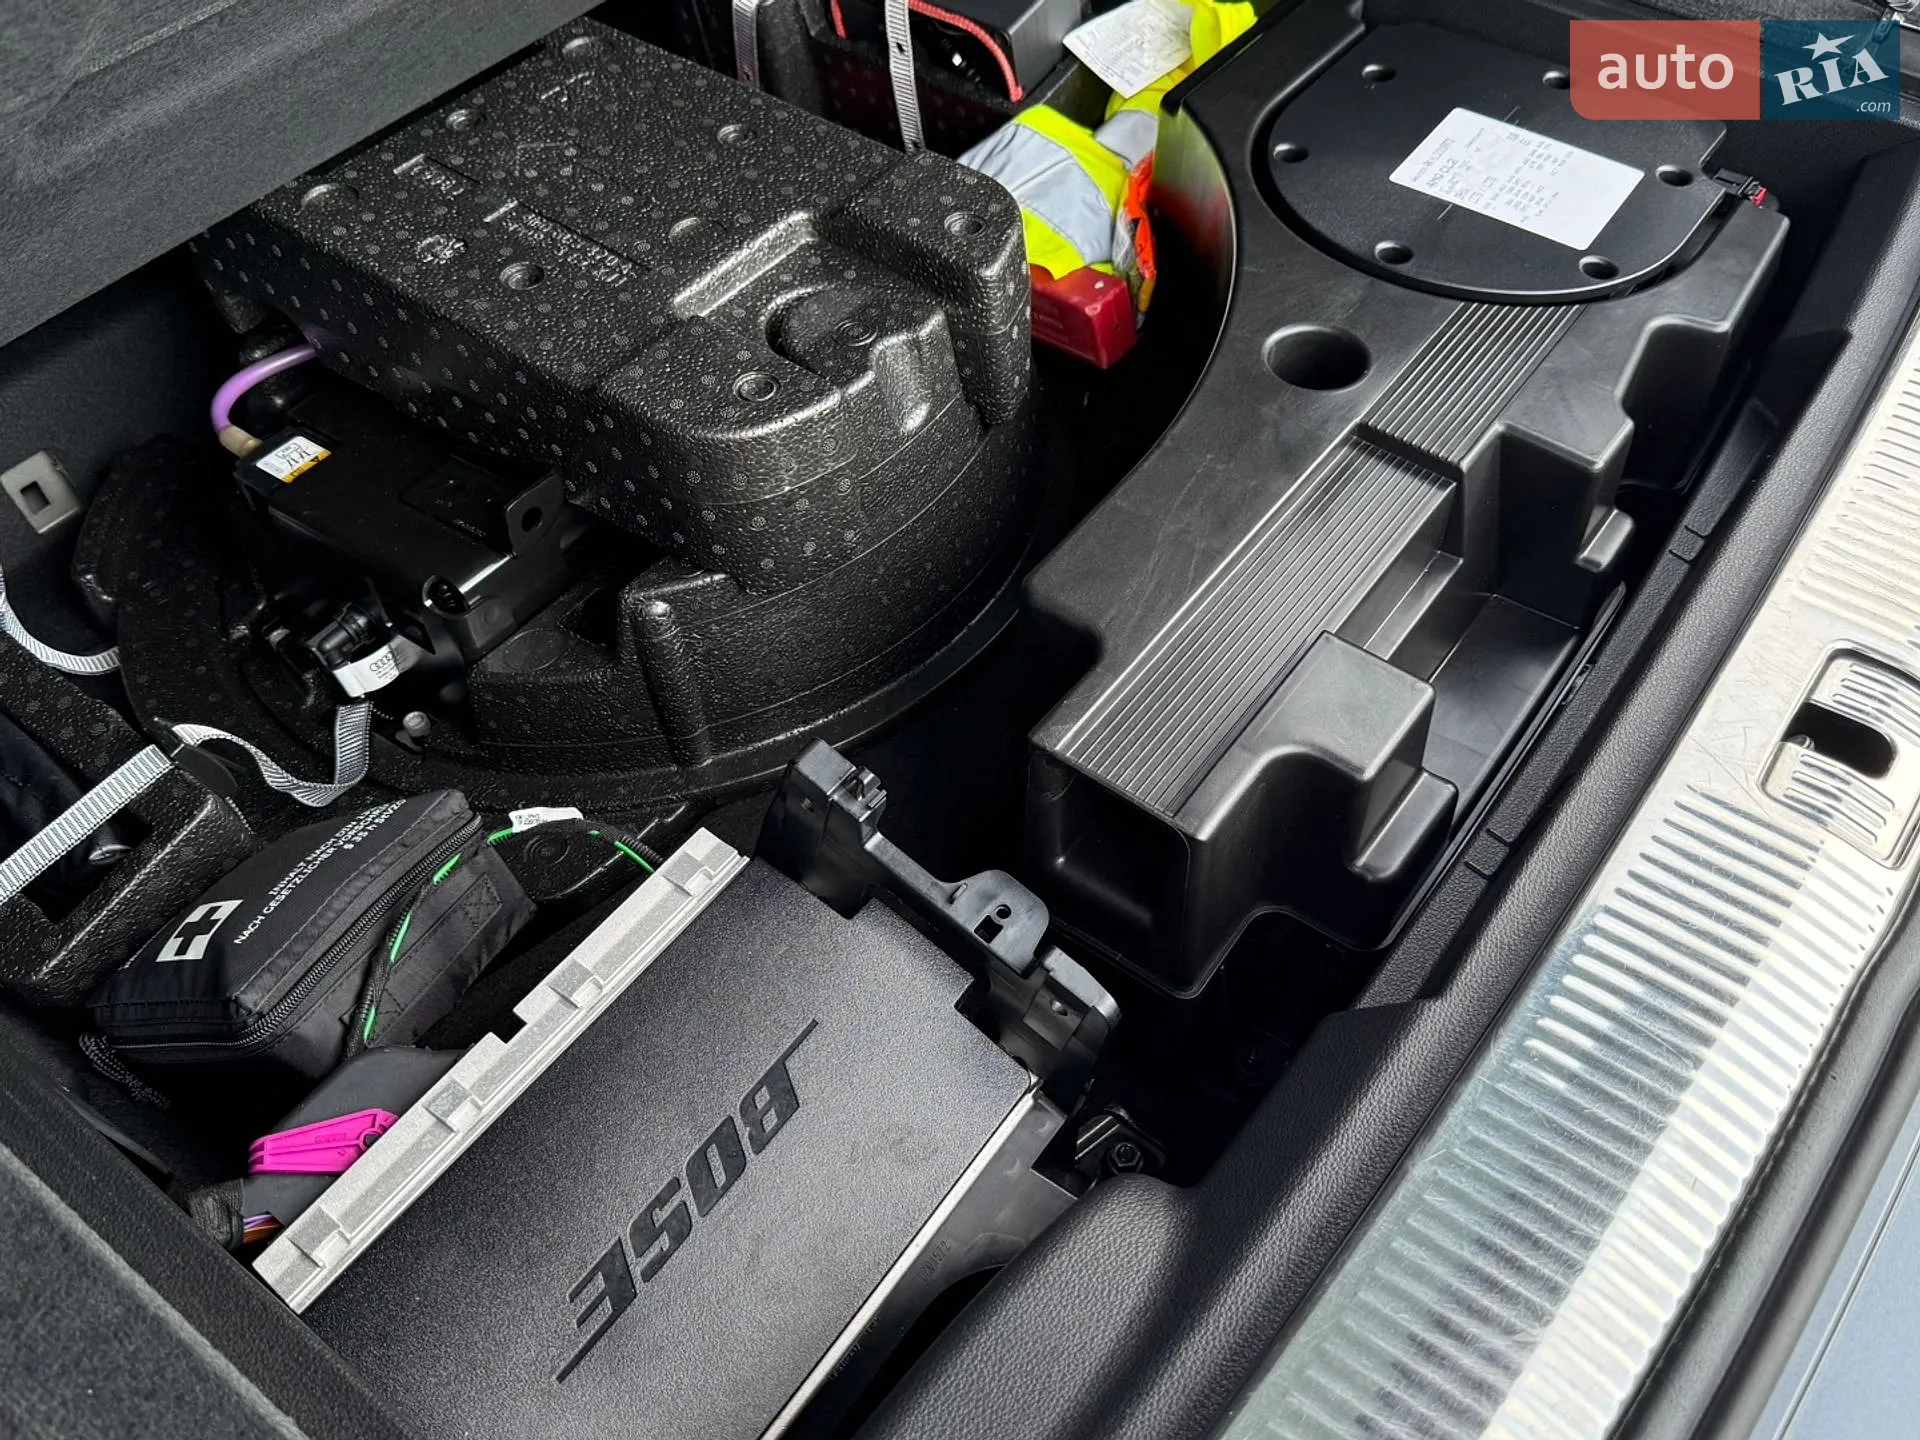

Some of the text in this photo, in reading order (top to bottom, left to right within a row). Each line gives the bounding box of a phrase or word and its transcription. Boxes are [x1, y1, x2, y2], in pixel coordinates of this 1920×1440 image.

[233, 915, 265, 944] NACH
[263, 847, 338, 914] GESETZLICHER
[268, 861, 306, 895] INHALT
[305, 838, 338, 861] NACH
[335, 821, 358, 838] DIN
[555, 1018, 819, 1384] BOSE
